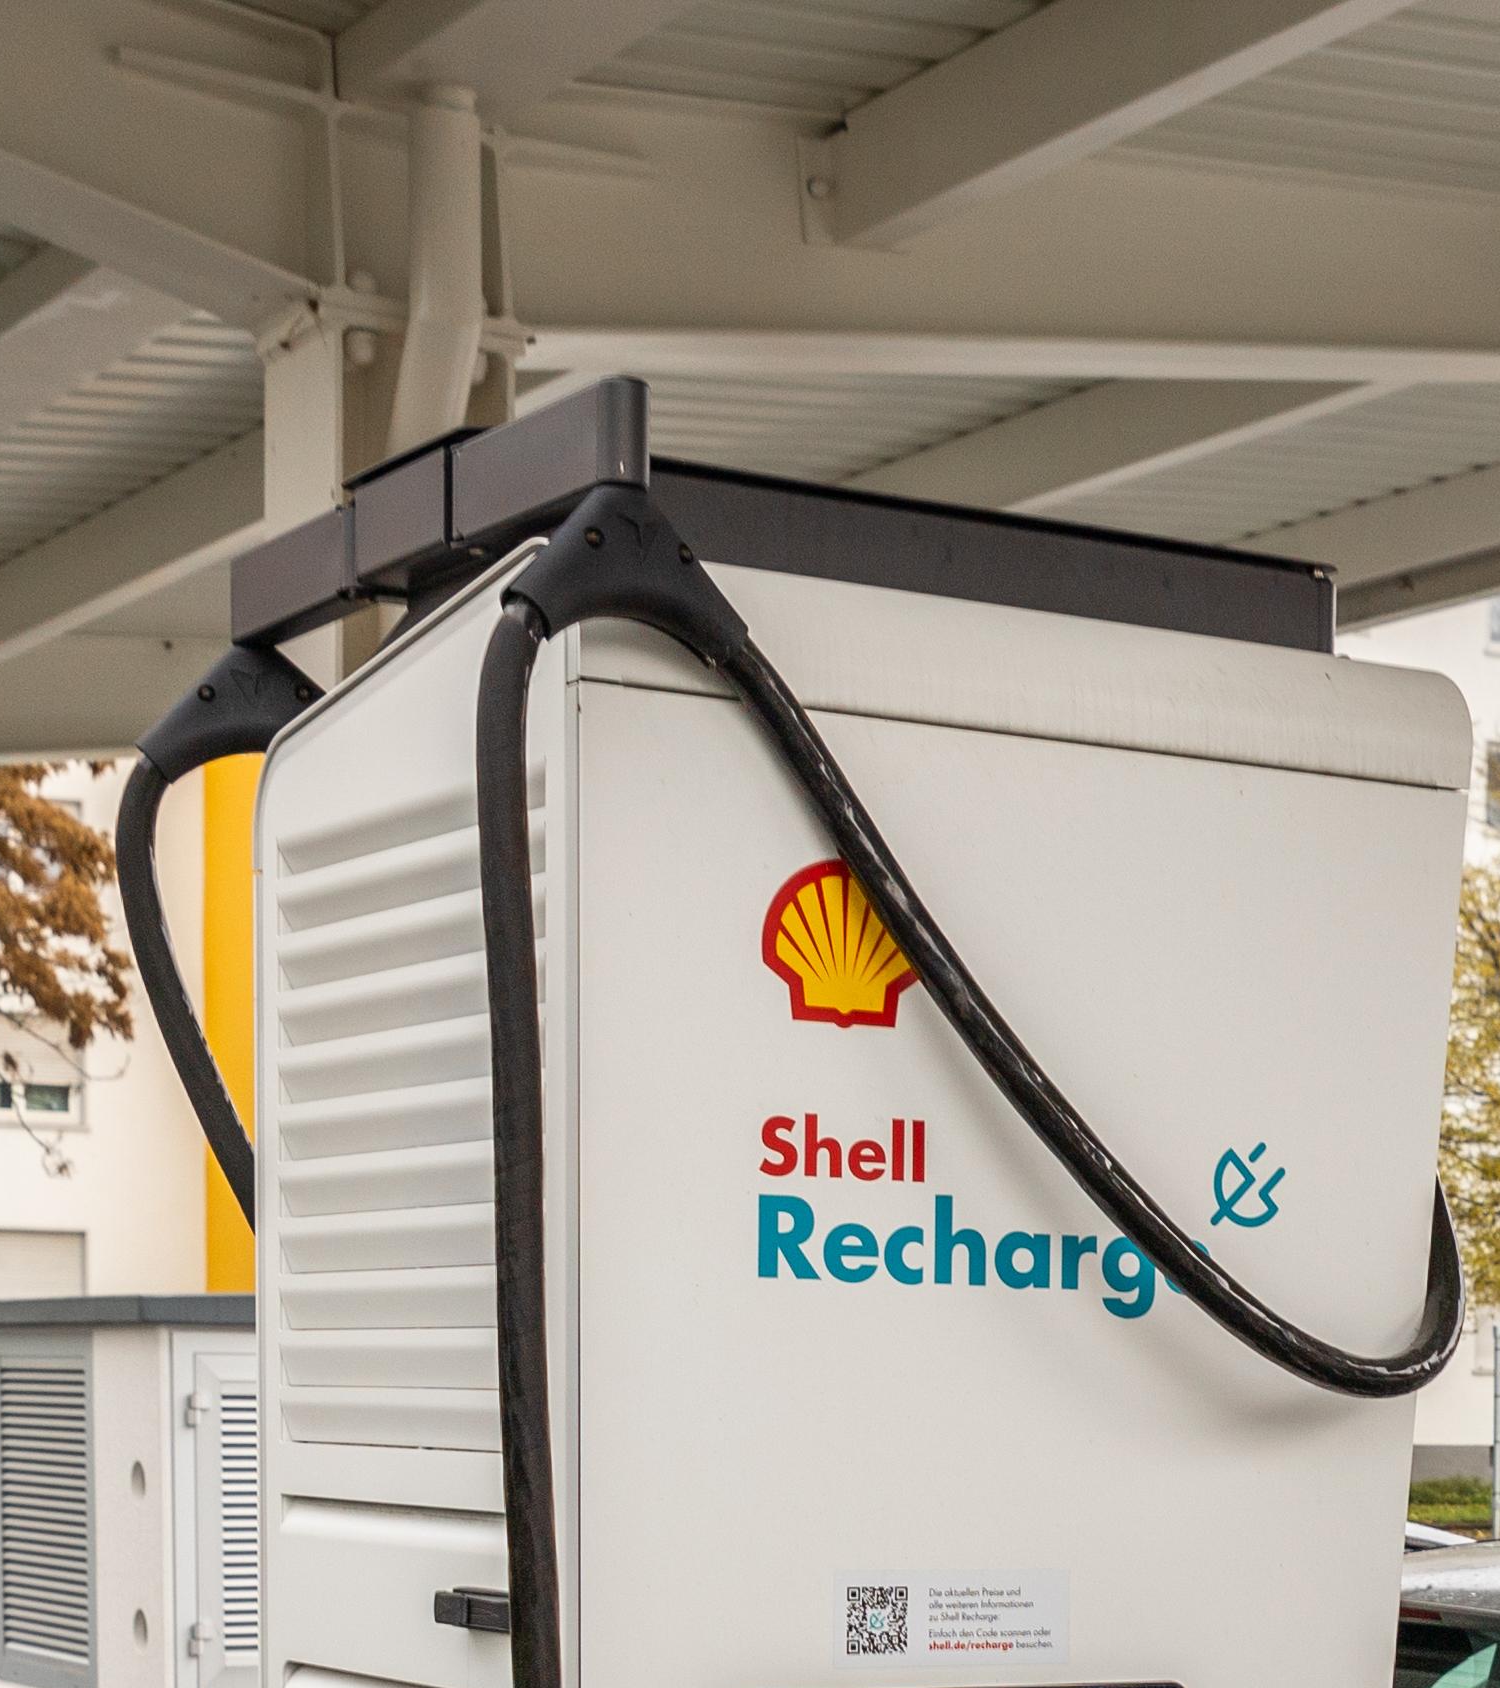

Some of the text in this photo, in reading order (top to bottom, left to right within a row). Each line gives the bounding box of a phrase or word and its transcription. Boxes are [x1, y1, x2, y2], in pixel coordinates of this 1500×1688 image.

[758, 1113, 926, 1183] Shell
[757, 1194, 1211, 1320] Recharg
[929, 1586, 1021, 1597] Die aktuellen Preise und
[929, 1600, 1034, 1609] alle weiteren Informationen
[940, 1611, 959, 1621] Shell
[928, 1626, 1051, 1638] Einfach den Code scannen oder
[928, 1640, 1014, 1651] shell.de/recharge
